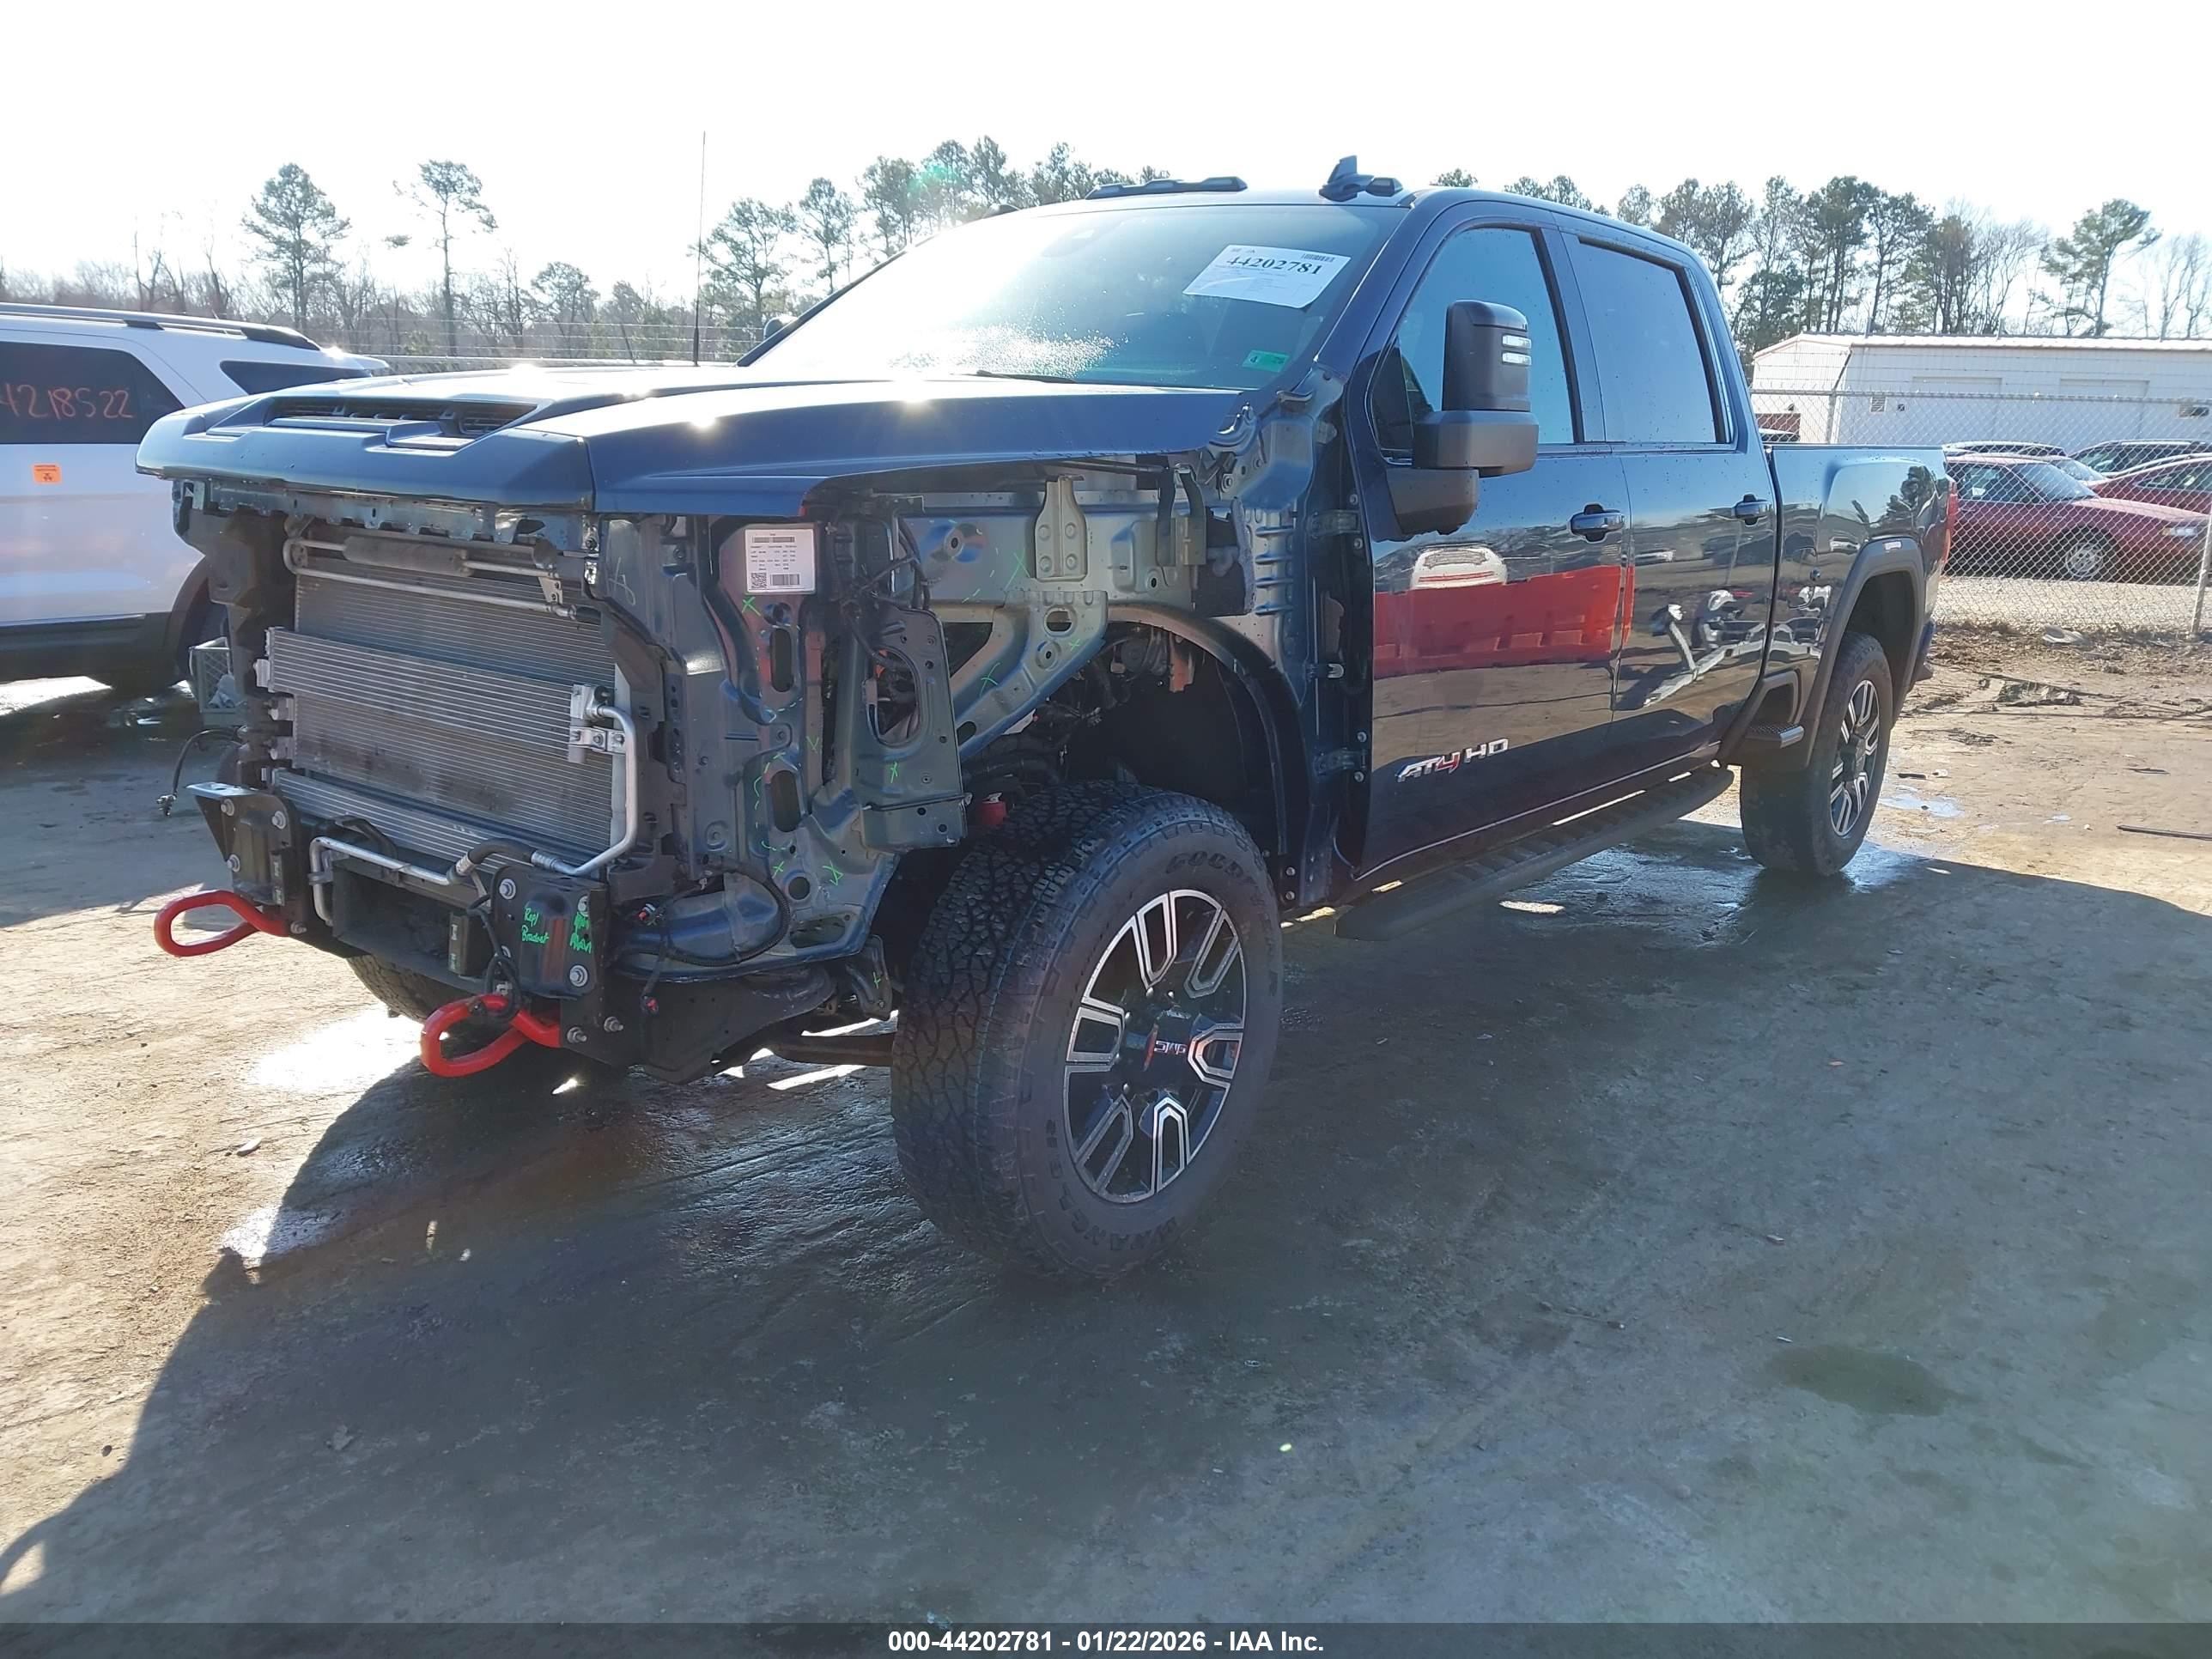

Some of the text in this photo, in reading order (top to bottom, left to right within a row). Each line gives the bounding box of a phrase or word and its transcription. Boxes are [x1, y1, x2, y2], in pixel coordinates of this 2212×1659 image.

[1226, 256, 1323, 275] 44202781
[1395, 737, 1510, 782] AT4 HD
[1153, 1040, 1188, 1055] GMC
